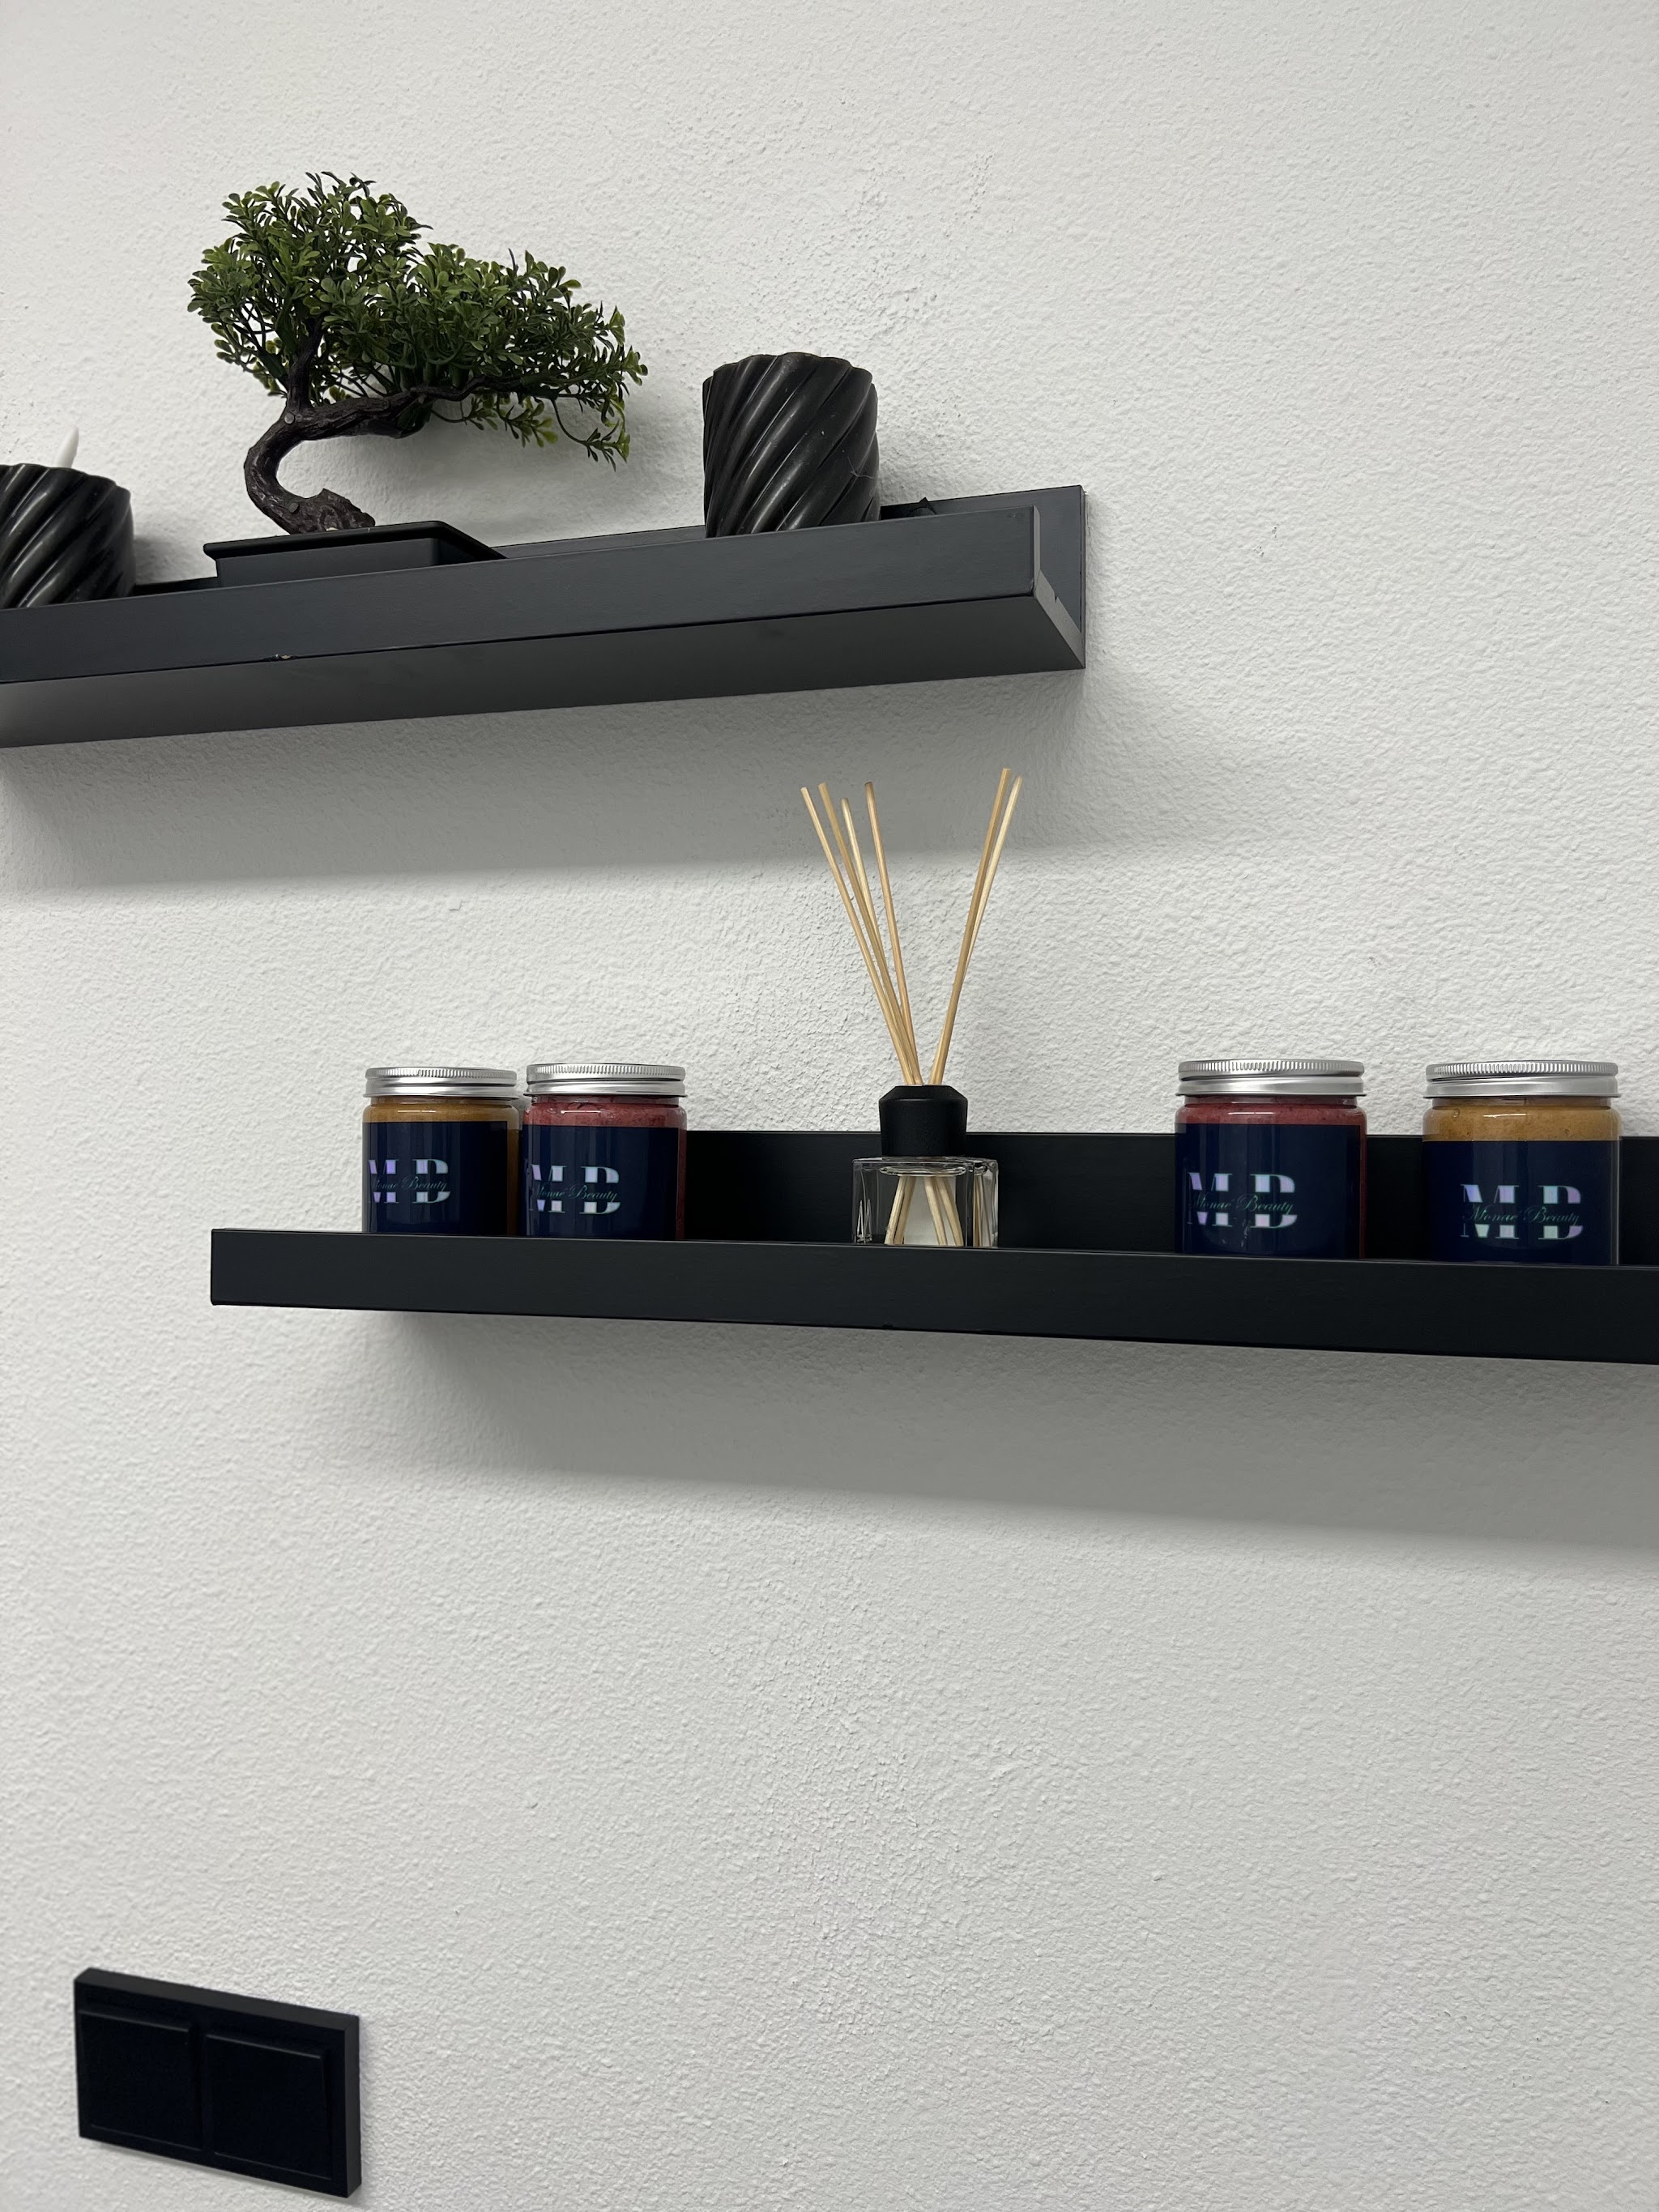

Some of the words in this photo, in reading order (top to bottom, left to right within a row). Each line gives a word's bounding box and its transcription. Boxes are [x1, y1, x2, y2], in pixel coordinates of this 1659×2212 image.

[401, 1174, 447, 1192] Beauty
[568, 1183, 617, 1204] Beauty
[1236, 1193, 1294, 1215] Beauty
[1523, 1204, 1580, 1226] Beauty
